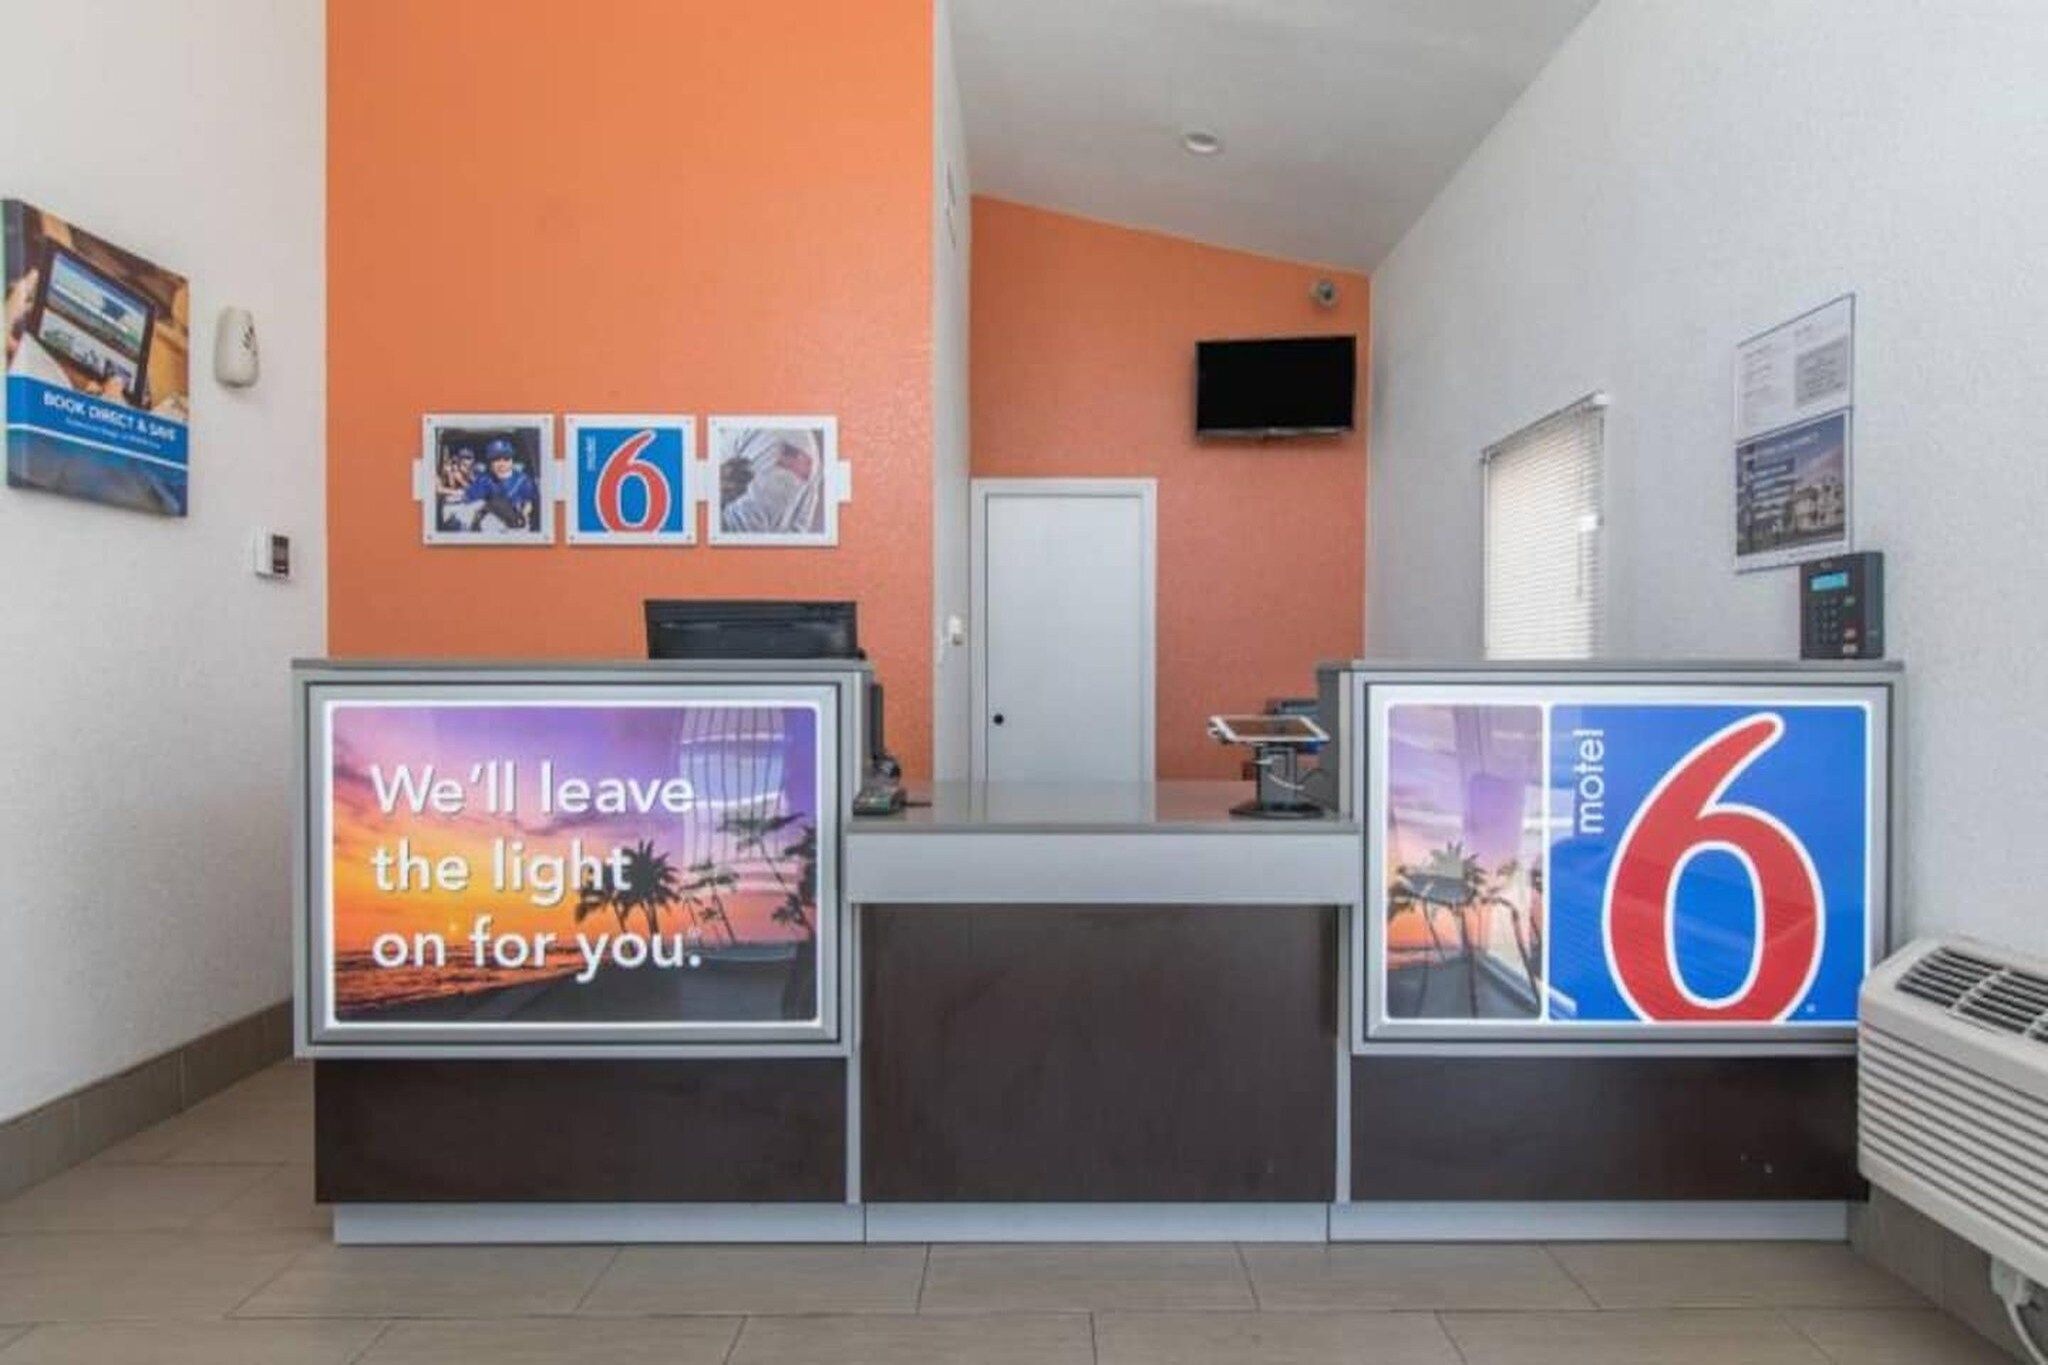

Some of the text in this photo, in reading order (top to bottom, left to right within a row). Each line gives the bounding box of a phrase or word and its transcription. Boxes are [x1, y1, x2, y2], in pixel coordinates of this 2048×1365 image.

[43, 391, 86, 415] BOOK
[88, 405, 134, 429] DIRECT
[595, 430, 671, 533] 6
[371, 760, 694, 813] We'll leave
[1573, 728, 1605, 834] motel
[371, 838, 632, 906] the light
[1602, 712, 1826, 1023] 6
[372, 915, 702, 983] on for you.
